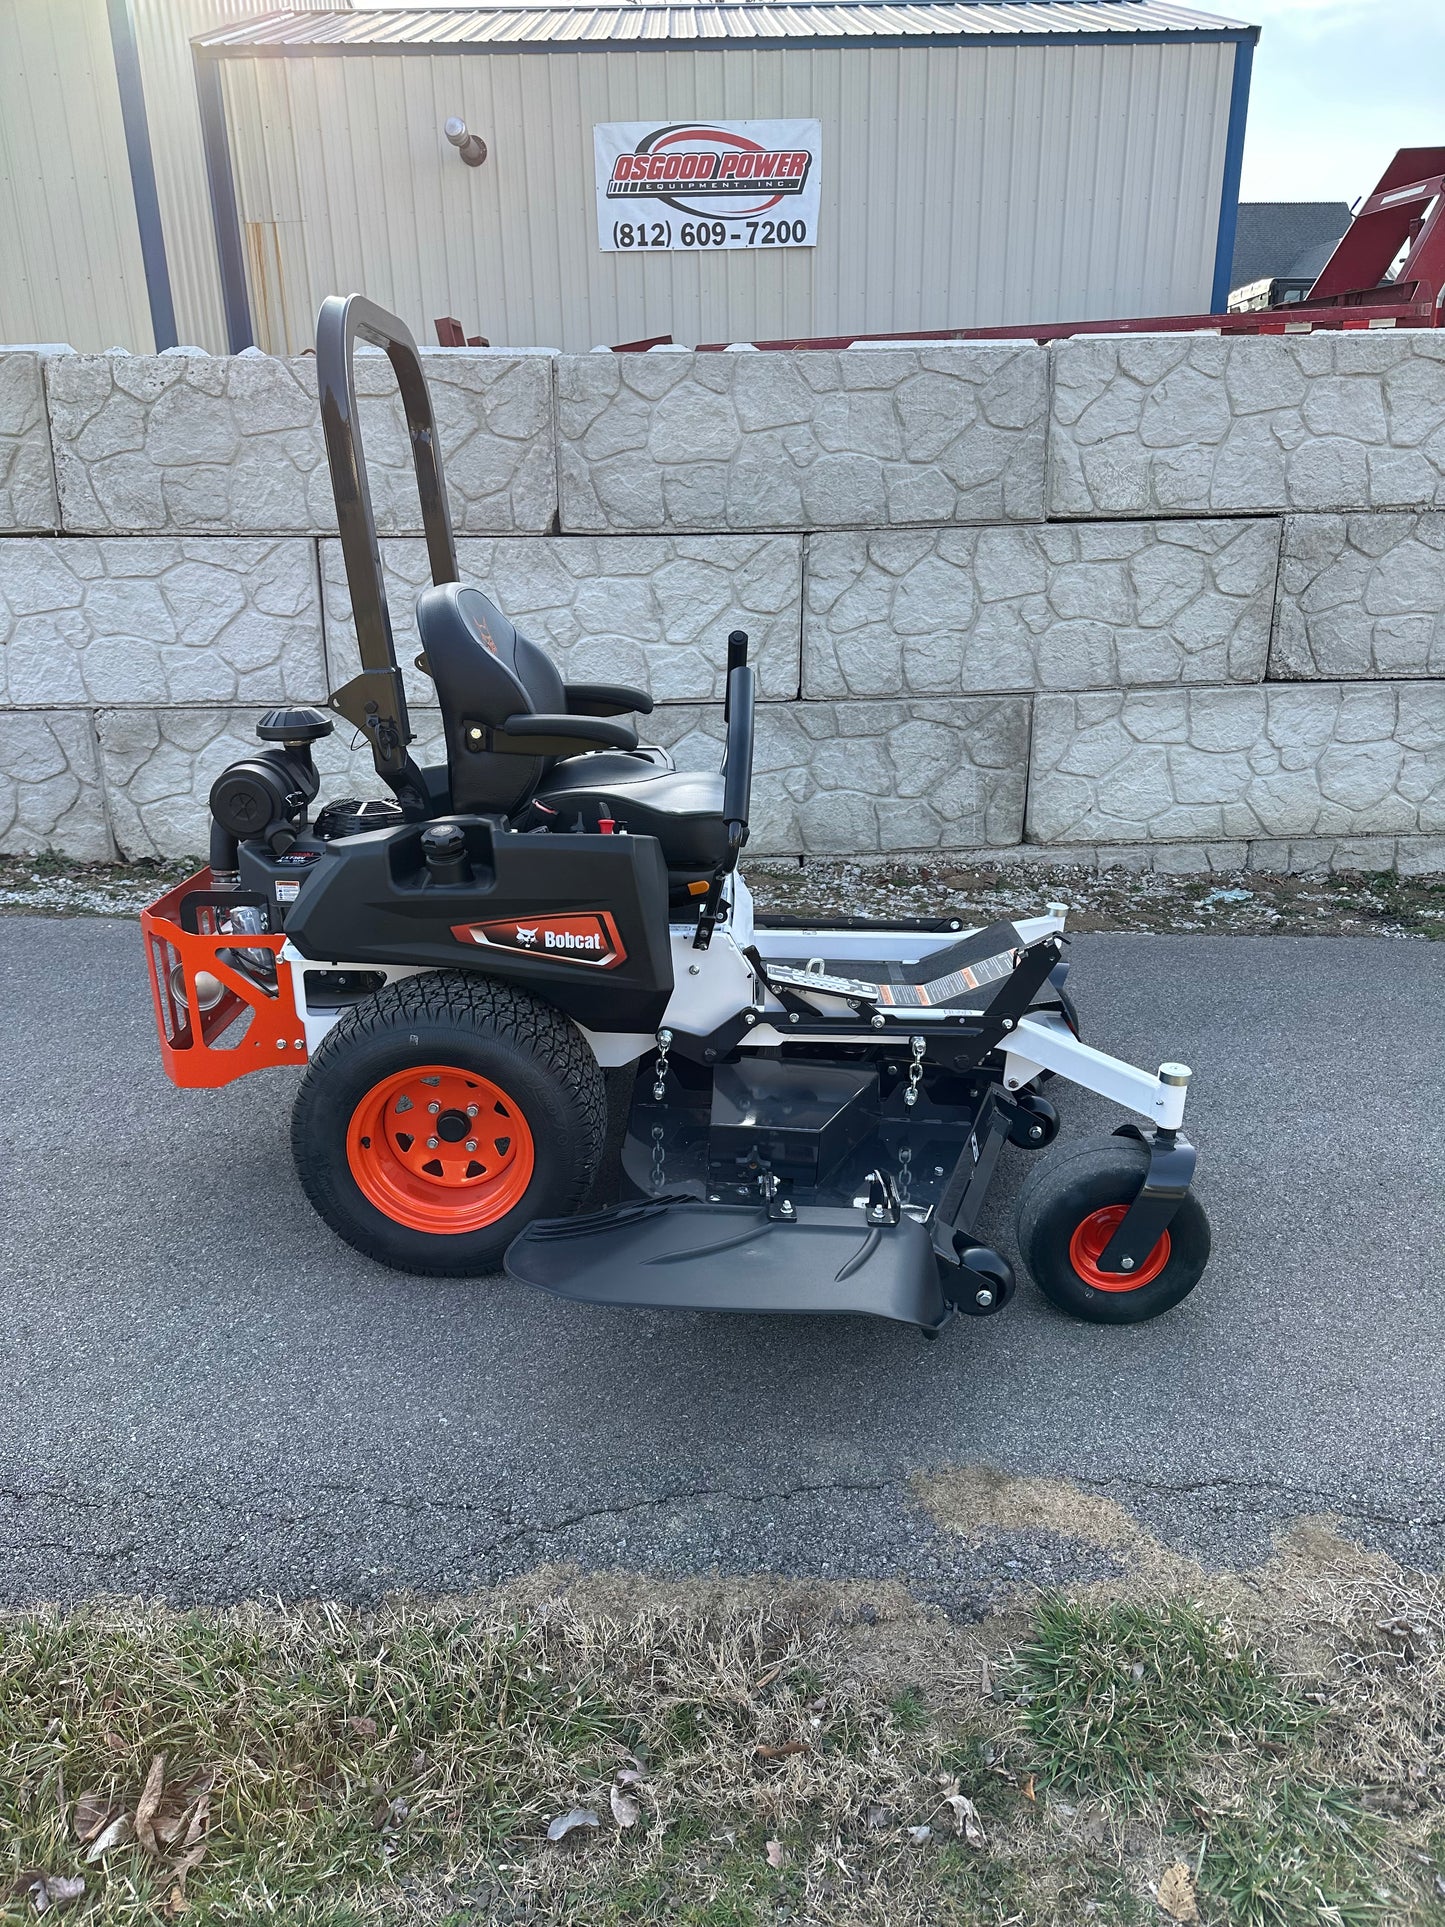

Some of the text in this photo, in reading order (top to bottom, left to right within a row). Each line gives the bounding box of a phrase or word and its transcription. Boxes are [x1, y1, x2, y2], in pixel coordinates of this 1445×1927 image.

[613, 152, 808, 181] OSGOOD POWER
[613, 220, 671, 248] (812)
[544, 931, 601, 950] Bobcat
